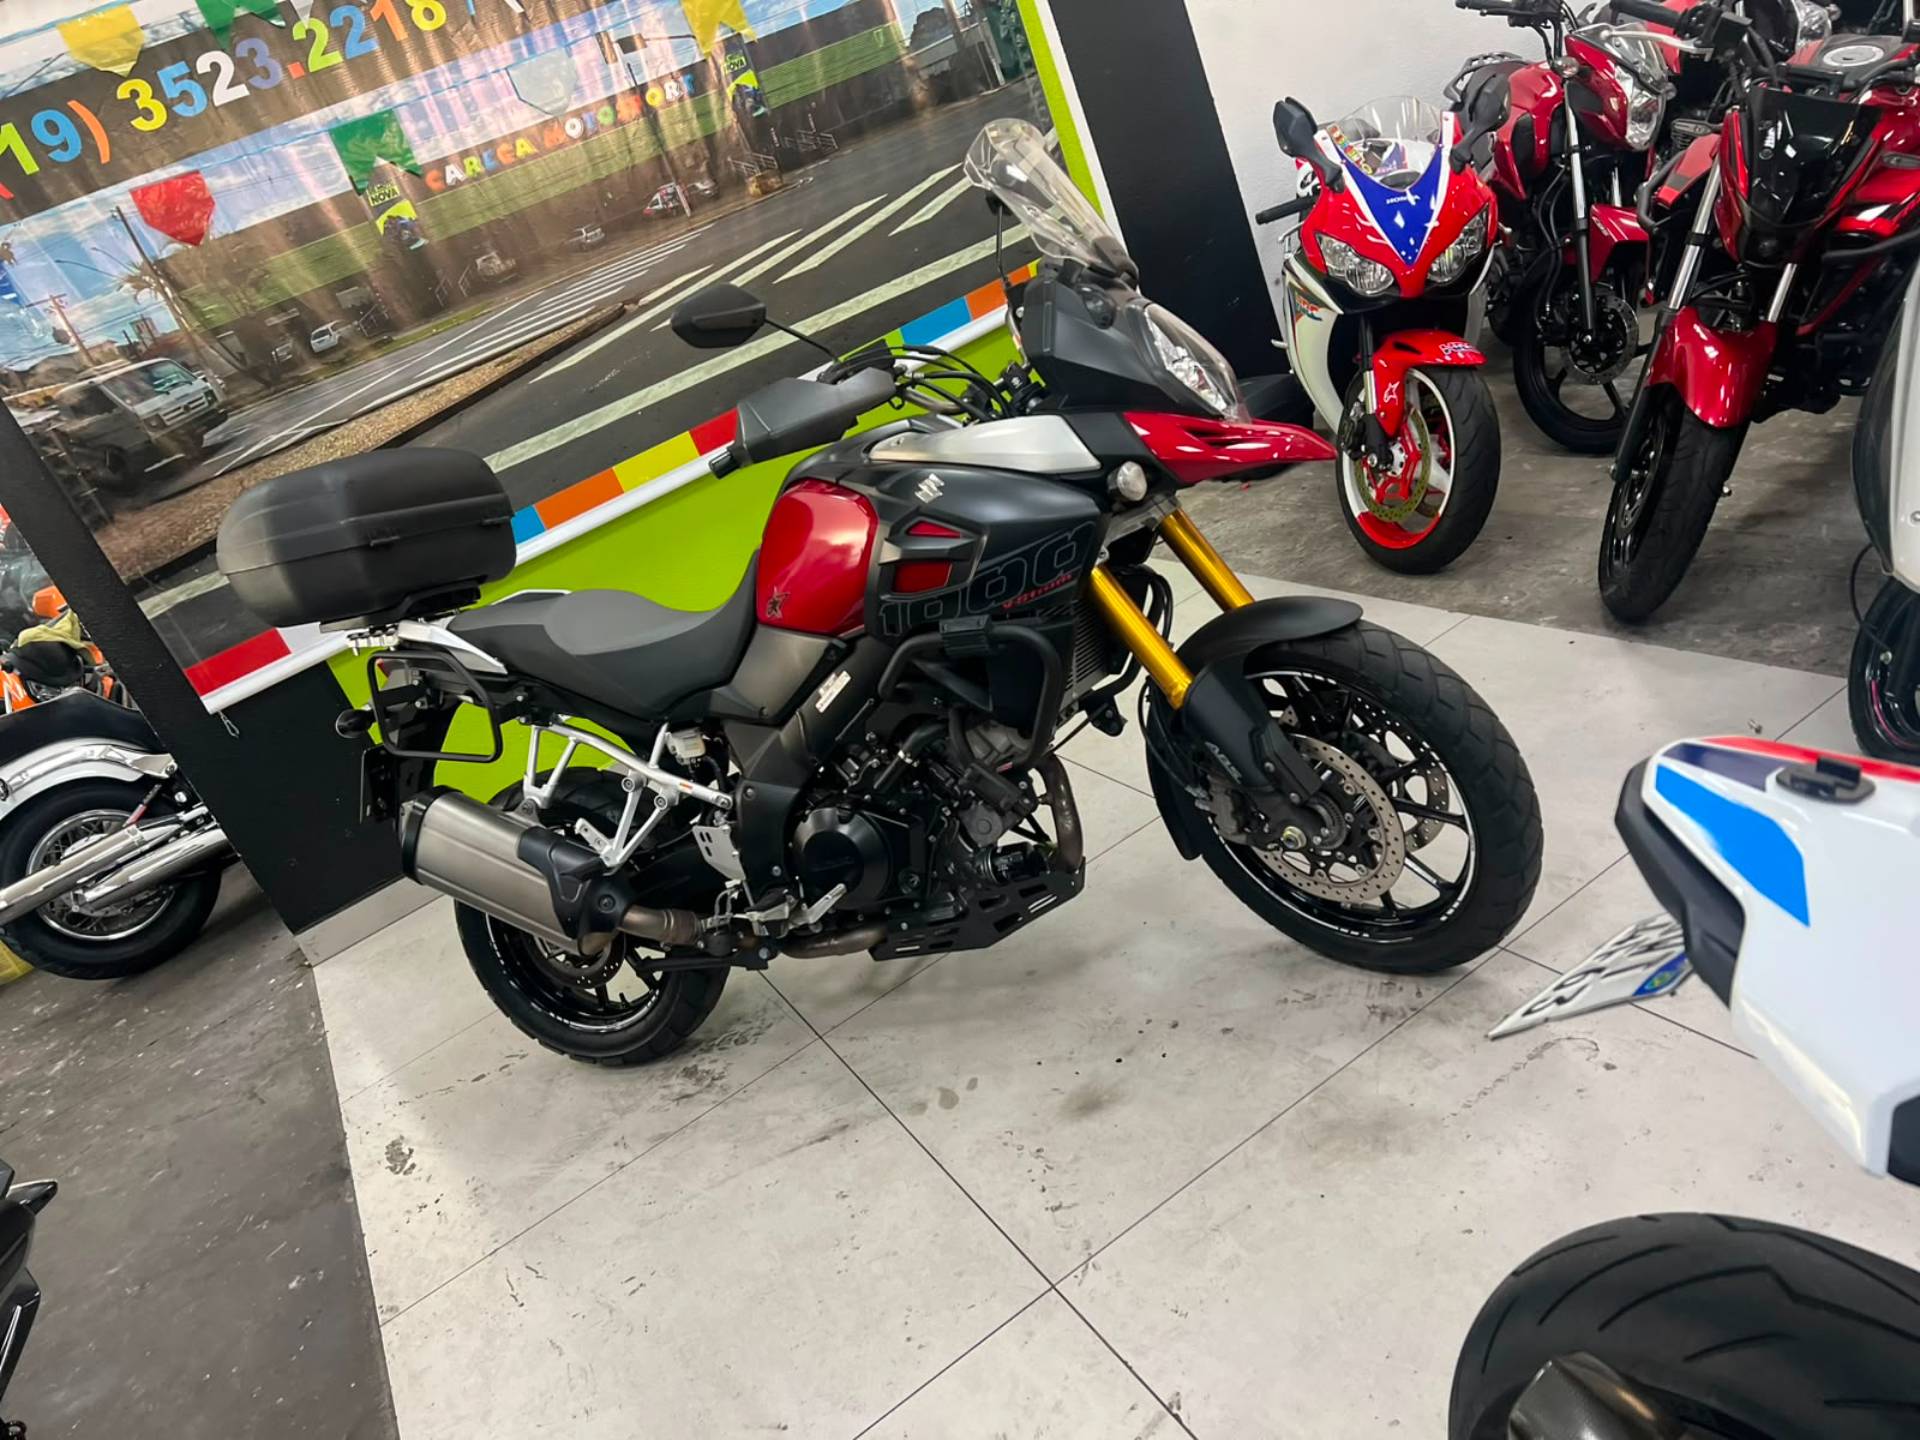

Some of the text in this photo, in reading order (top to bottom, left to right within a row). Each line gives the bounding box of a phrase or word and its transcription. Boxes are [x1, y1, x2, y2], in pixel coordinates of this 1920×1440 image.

[0, 100, 110, 199] 19)
[425, 137, 538, 192] CARECA
[1386, 195, 1420, 204] HONA
